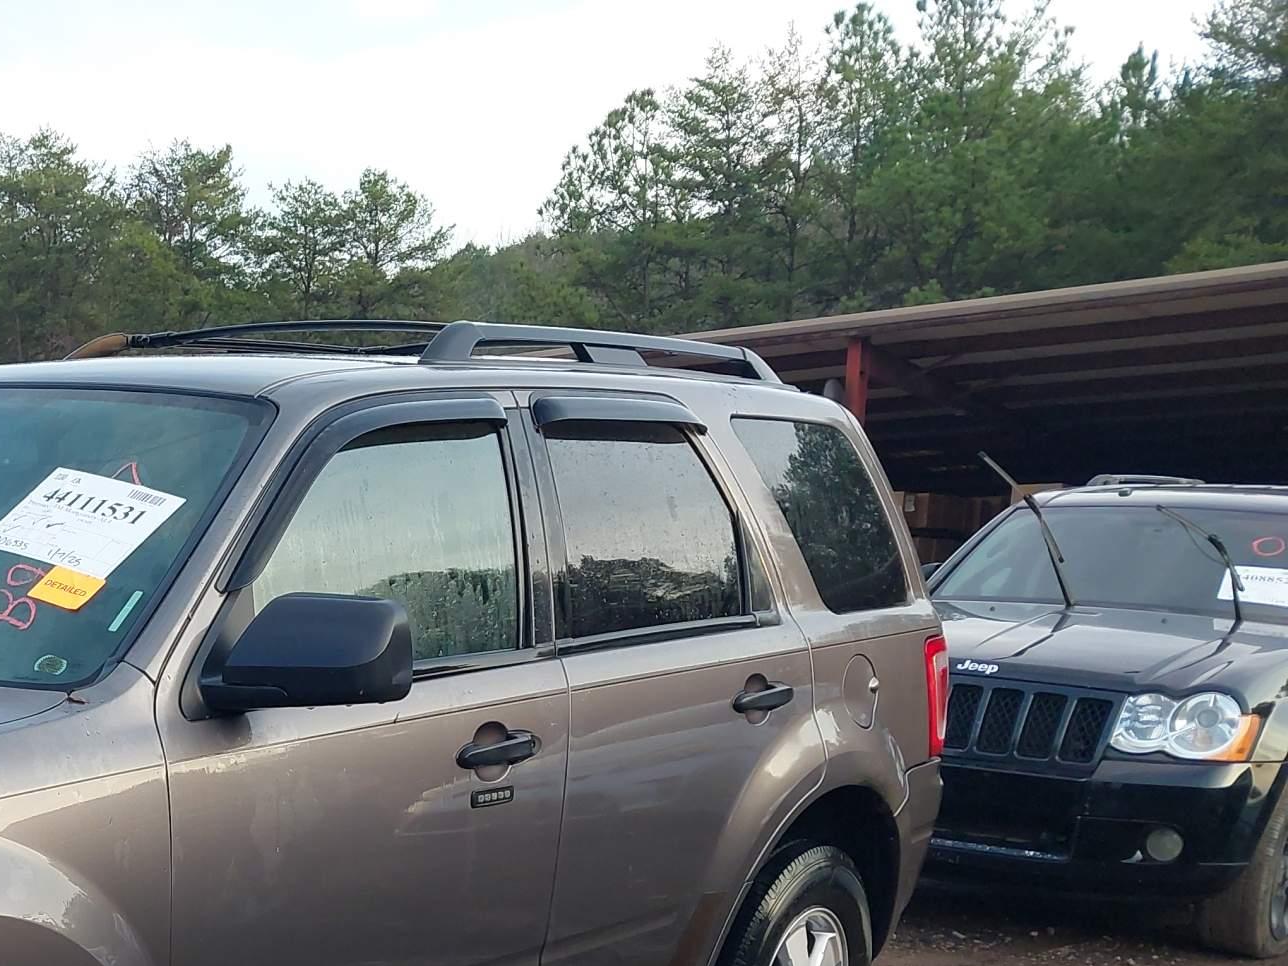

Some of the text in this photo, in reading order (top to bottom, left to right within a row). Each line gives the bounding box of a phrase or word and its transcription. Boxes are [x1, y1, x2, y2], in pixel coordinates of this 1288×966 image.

[43, 488, 147, 524] 44111531
[44, 578, 87, 597] DETAILED
[956, 659, 999, 675] Jeep
